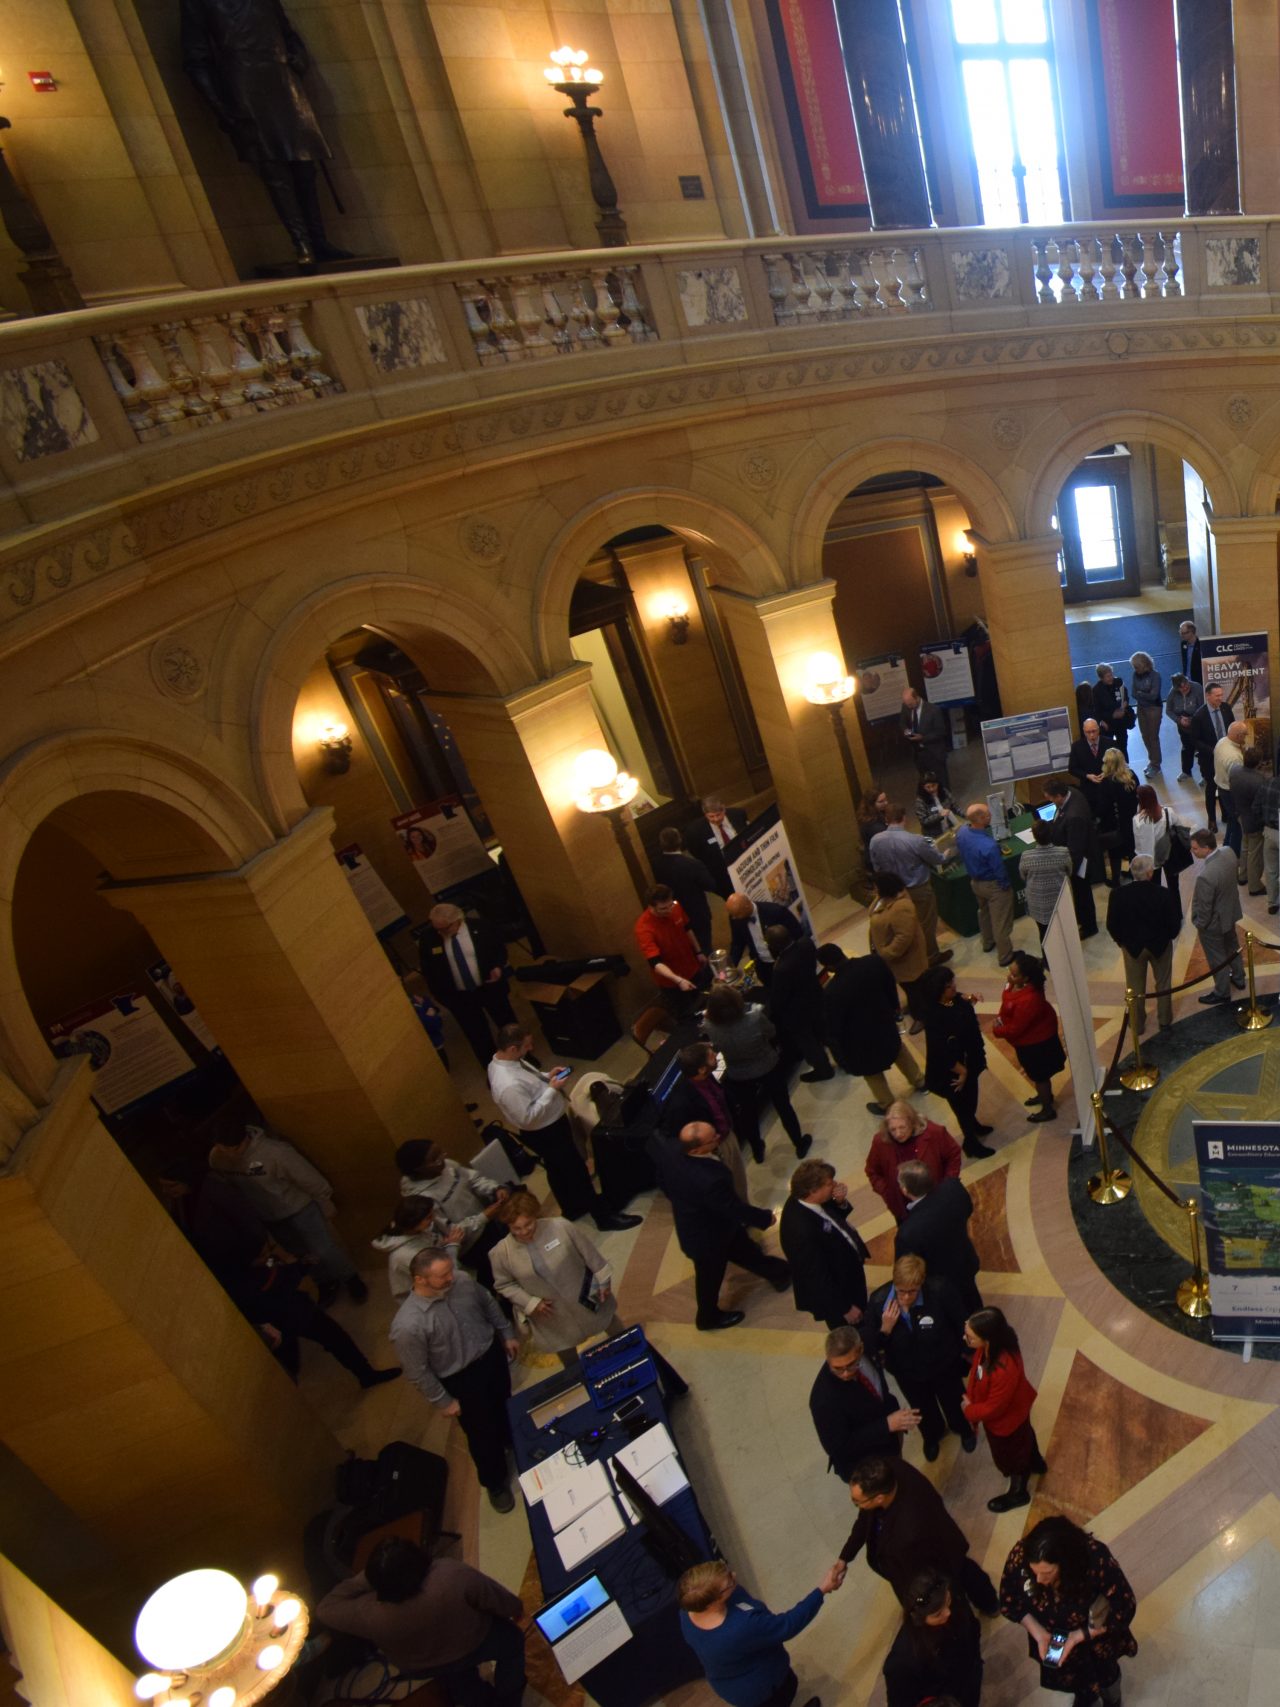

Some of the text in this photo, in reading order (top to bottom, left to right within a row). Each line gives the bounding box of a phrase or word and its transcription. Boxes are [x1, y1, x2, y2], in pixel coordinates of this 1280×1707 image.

[1216, 644, 1233, 653] CLC
[1207, 661, 1241, 672] HEAVY
[1207, 667, 1265, 680] EQUIPMENT
[1227, 1144, 1280, 1152] MINNESOTA
